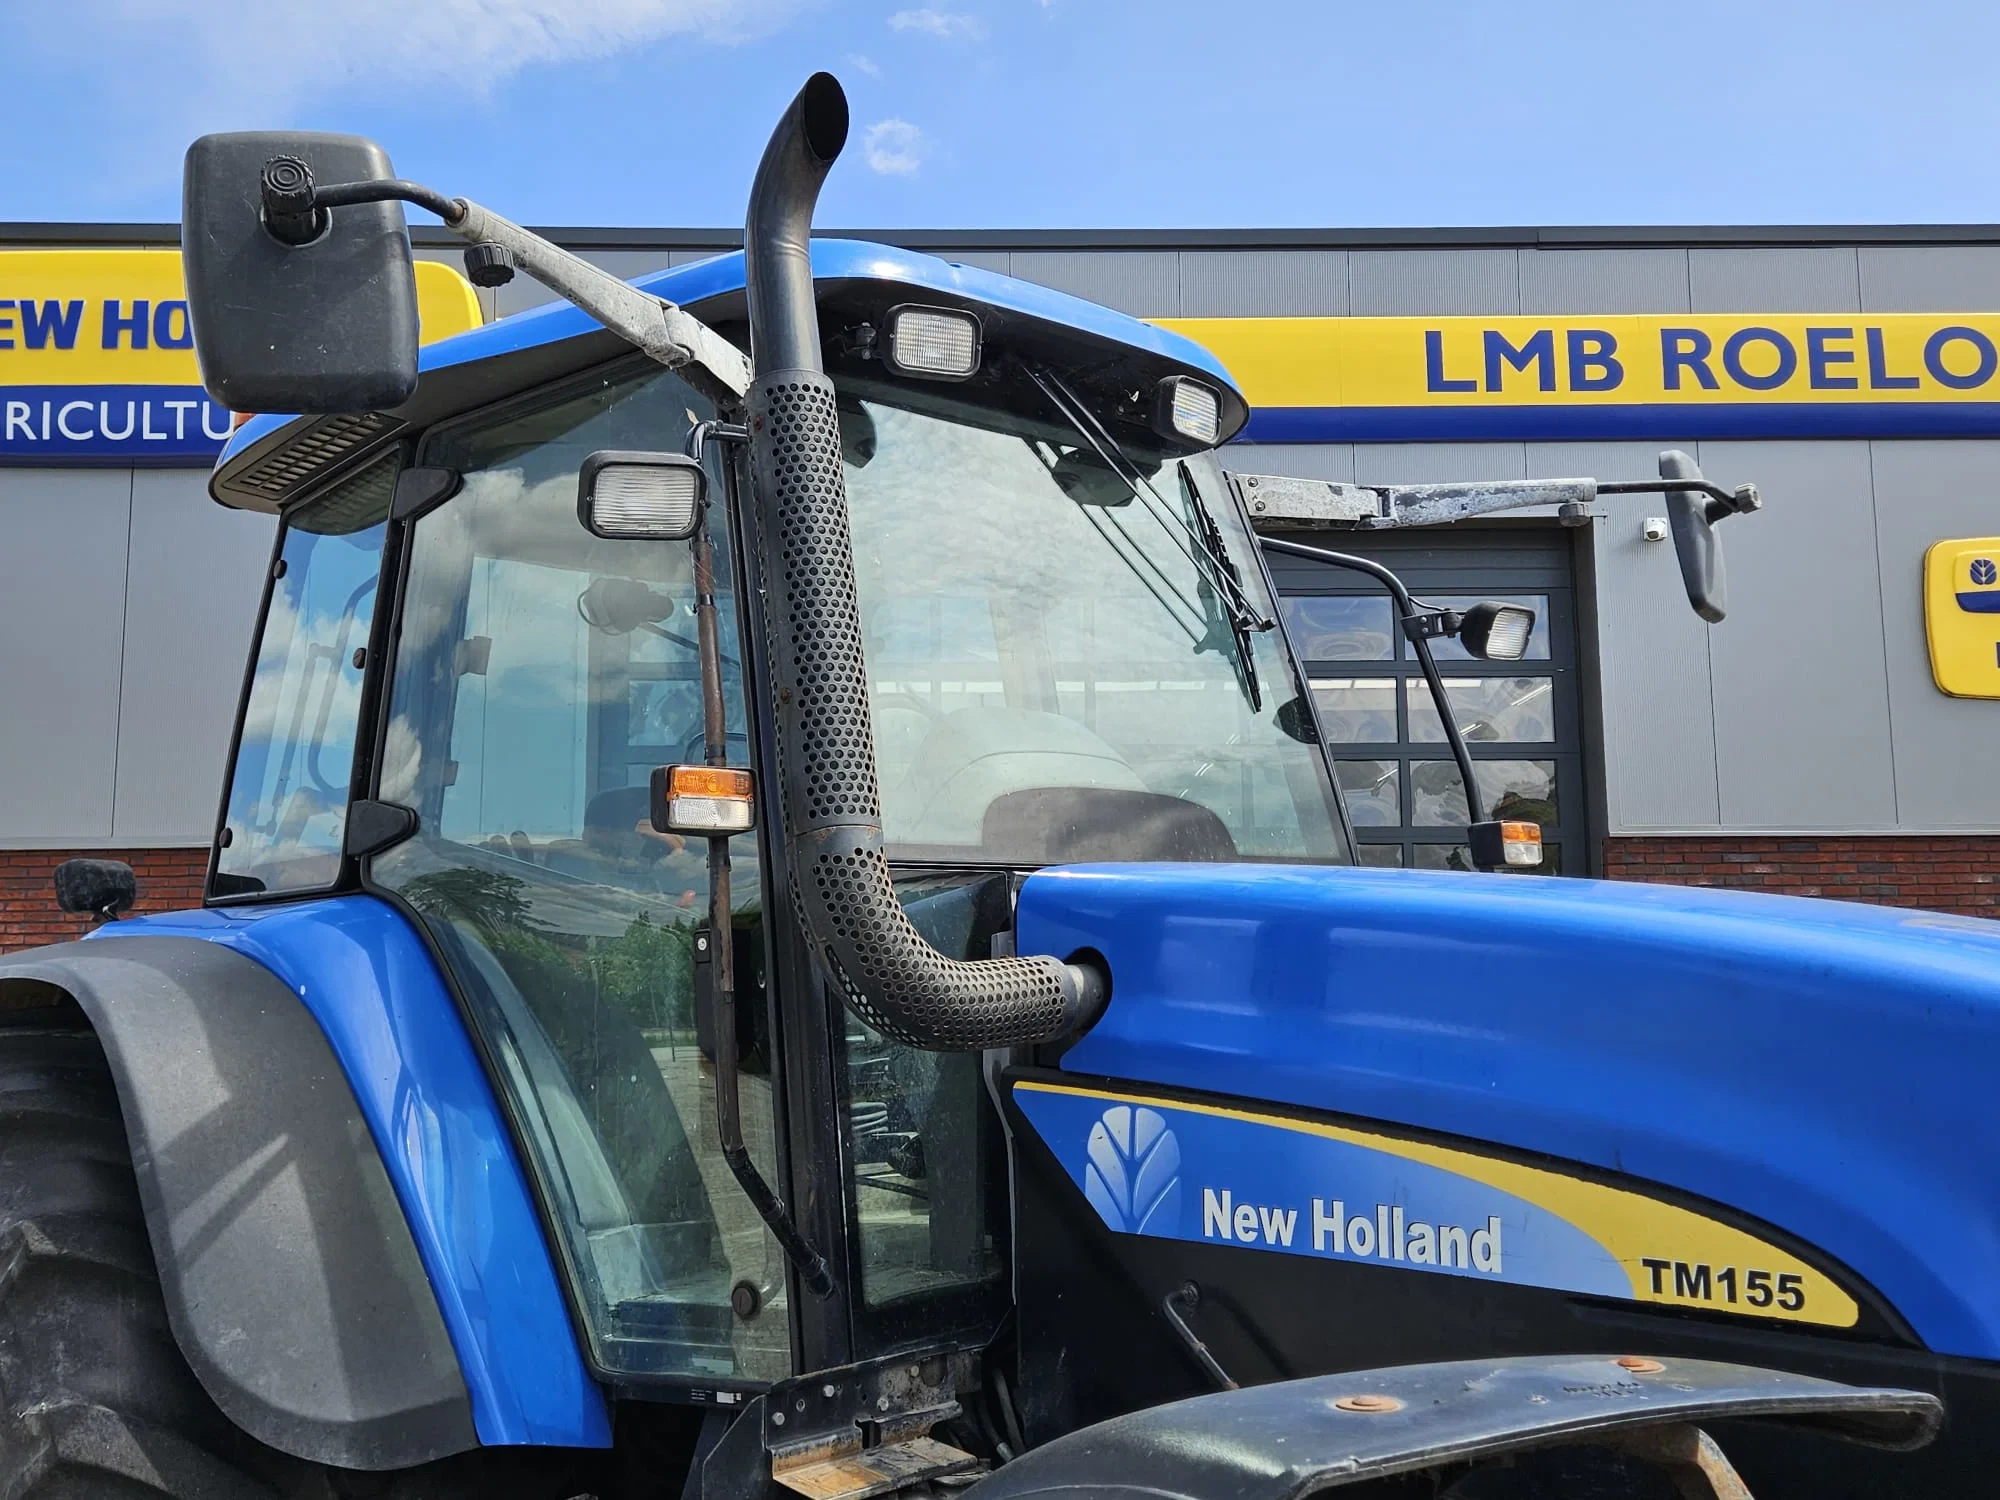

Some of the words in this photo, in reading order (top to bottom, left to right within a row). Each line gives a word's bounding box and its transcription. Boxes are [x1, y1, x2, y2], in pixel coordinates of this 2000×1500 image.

[101, 299, 195, 350] HO
[1425, 329, 1624, 393] LMB
[1660, 326, 1998, 391] ROELO
[6, 400, 235, 440] RICULTU
[1203, 1188, 1297, 1247] New
[1311, 1197, 1502, 1274] Holland
[1641, 1257, 1806, 1312] TM155
